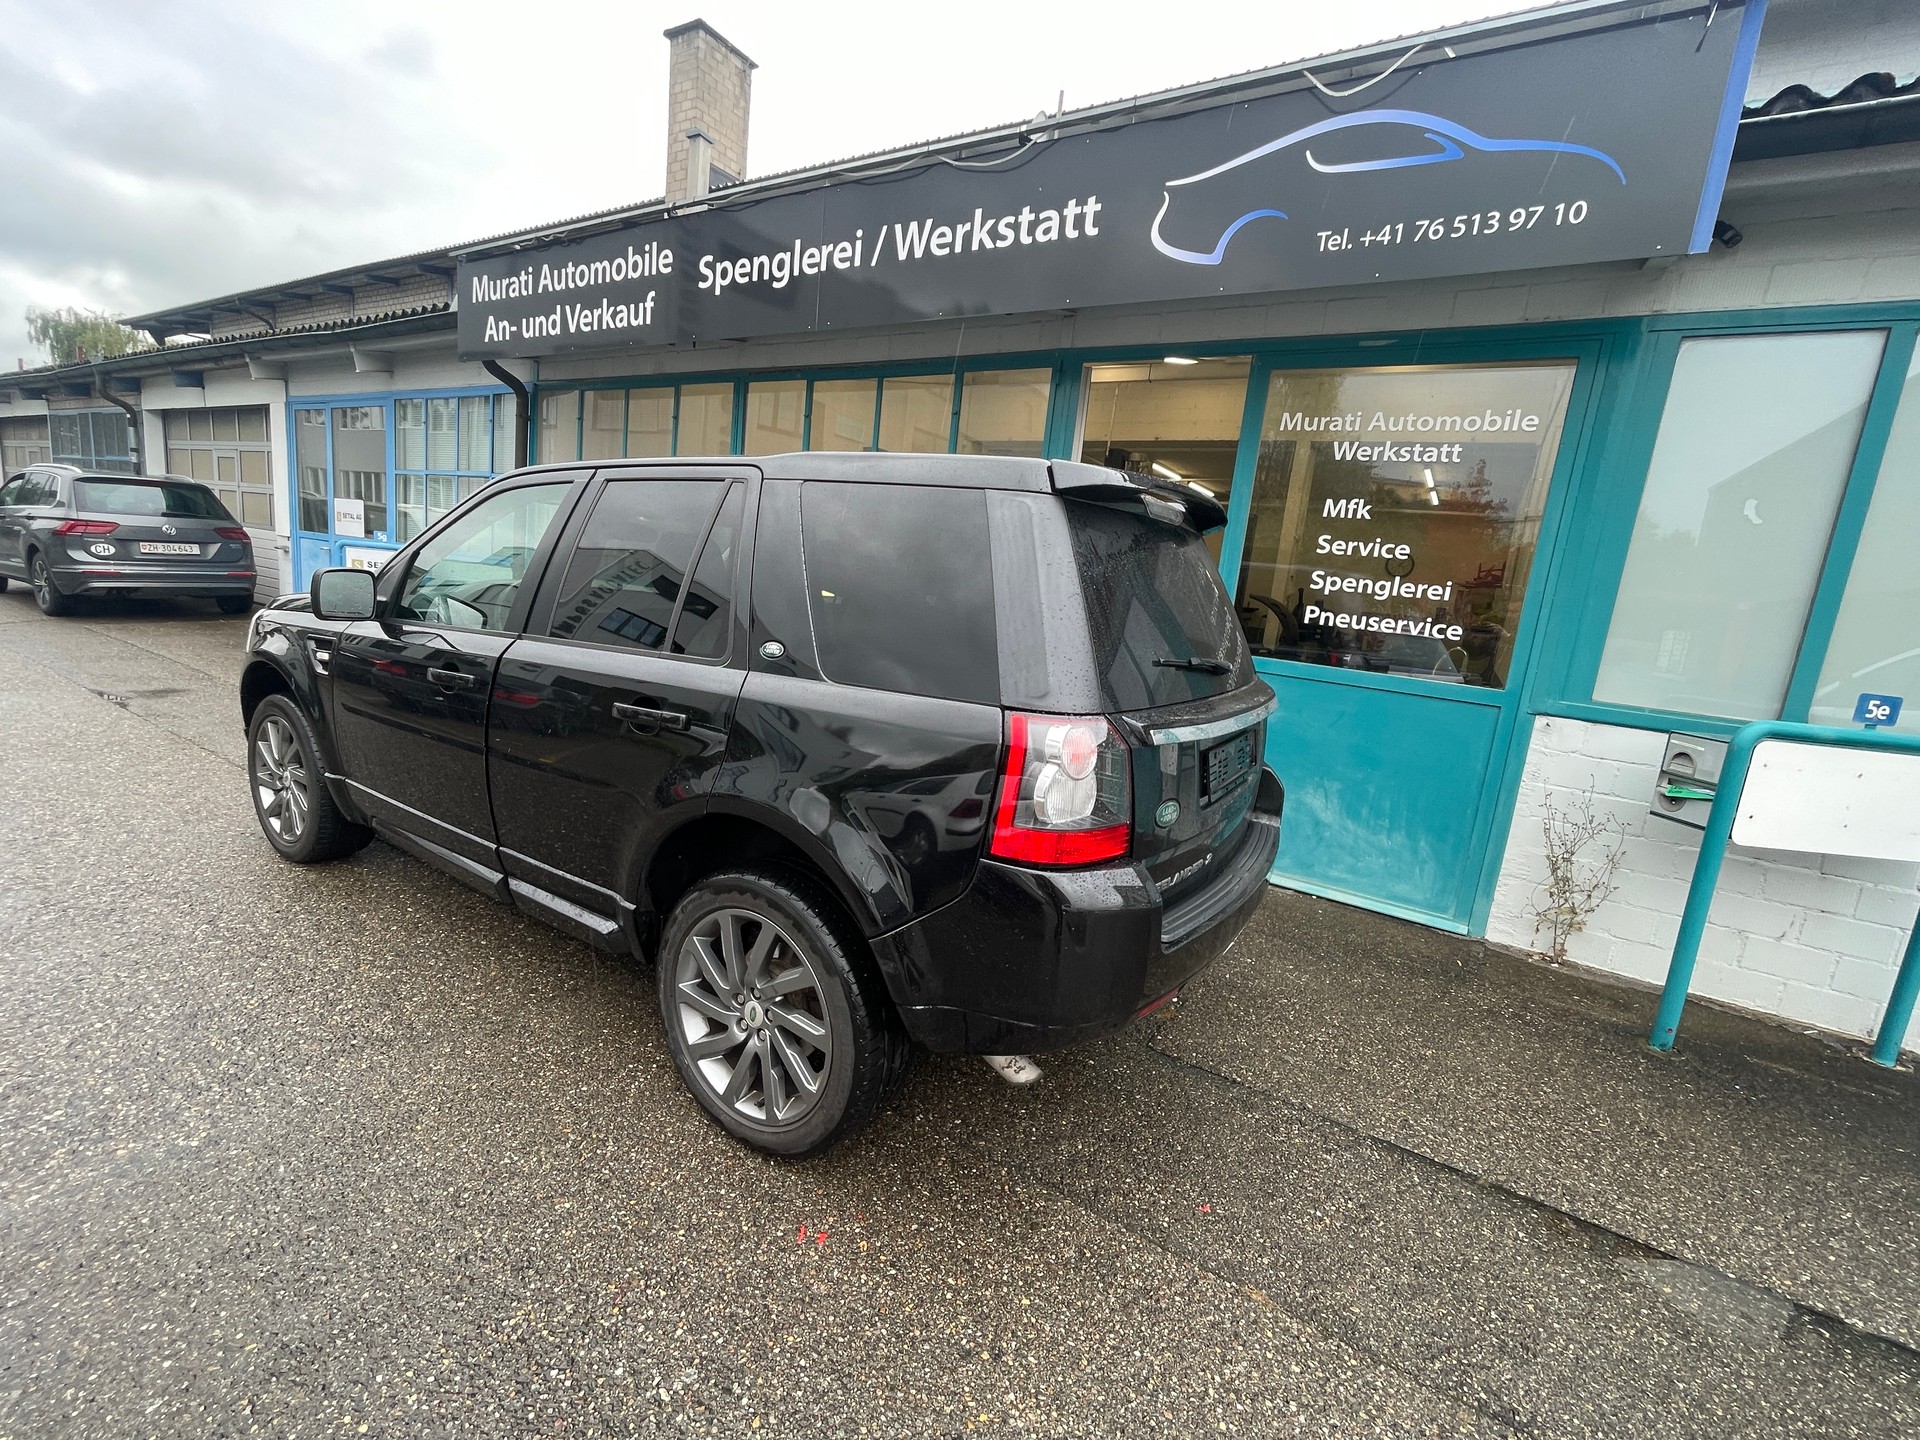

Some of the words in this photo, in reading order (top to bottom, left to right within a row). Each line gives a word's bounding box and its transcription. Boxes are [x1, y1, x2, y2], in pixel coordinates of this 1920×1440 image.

[1316, 225, 1354, 253] Tel.
[1359, 222, 1404, 248] +41
[1414, 218, 1445, 244] 76
[1452, 211, 1500, 237] 513
[1507, 205, 1545, 232] 97
[1554, 199, 1588, 226] 10
[698, 228, 863, 297] Spenglerei
[895, 195, 1102, 262] Werkstatt
[471, 268, 534, 304] Murati
[538, 241, 674, 292] Automobile
[484, 314, 518, 343] An-
[521, 303, 561, 338] und
[565, 291, 655, 334] Verkauf
[1279, 411, 1363, 432] Murati
[1367, 409, 1540, 432] Automobile
[1333, 441, 1463, 463] Werkstatt
[342, 512, 355, 520] SETAL
[1322, 498, 1372, 520] Mfk
[95, 545, 111, 554] CH
[1316, 534, 1411, 560] Service
[1309, 570, 1453, 601] Spenglerei
[1303, 605, 1463, 641] Pneuservice
[1864, 700, 1891, 720] 5e
